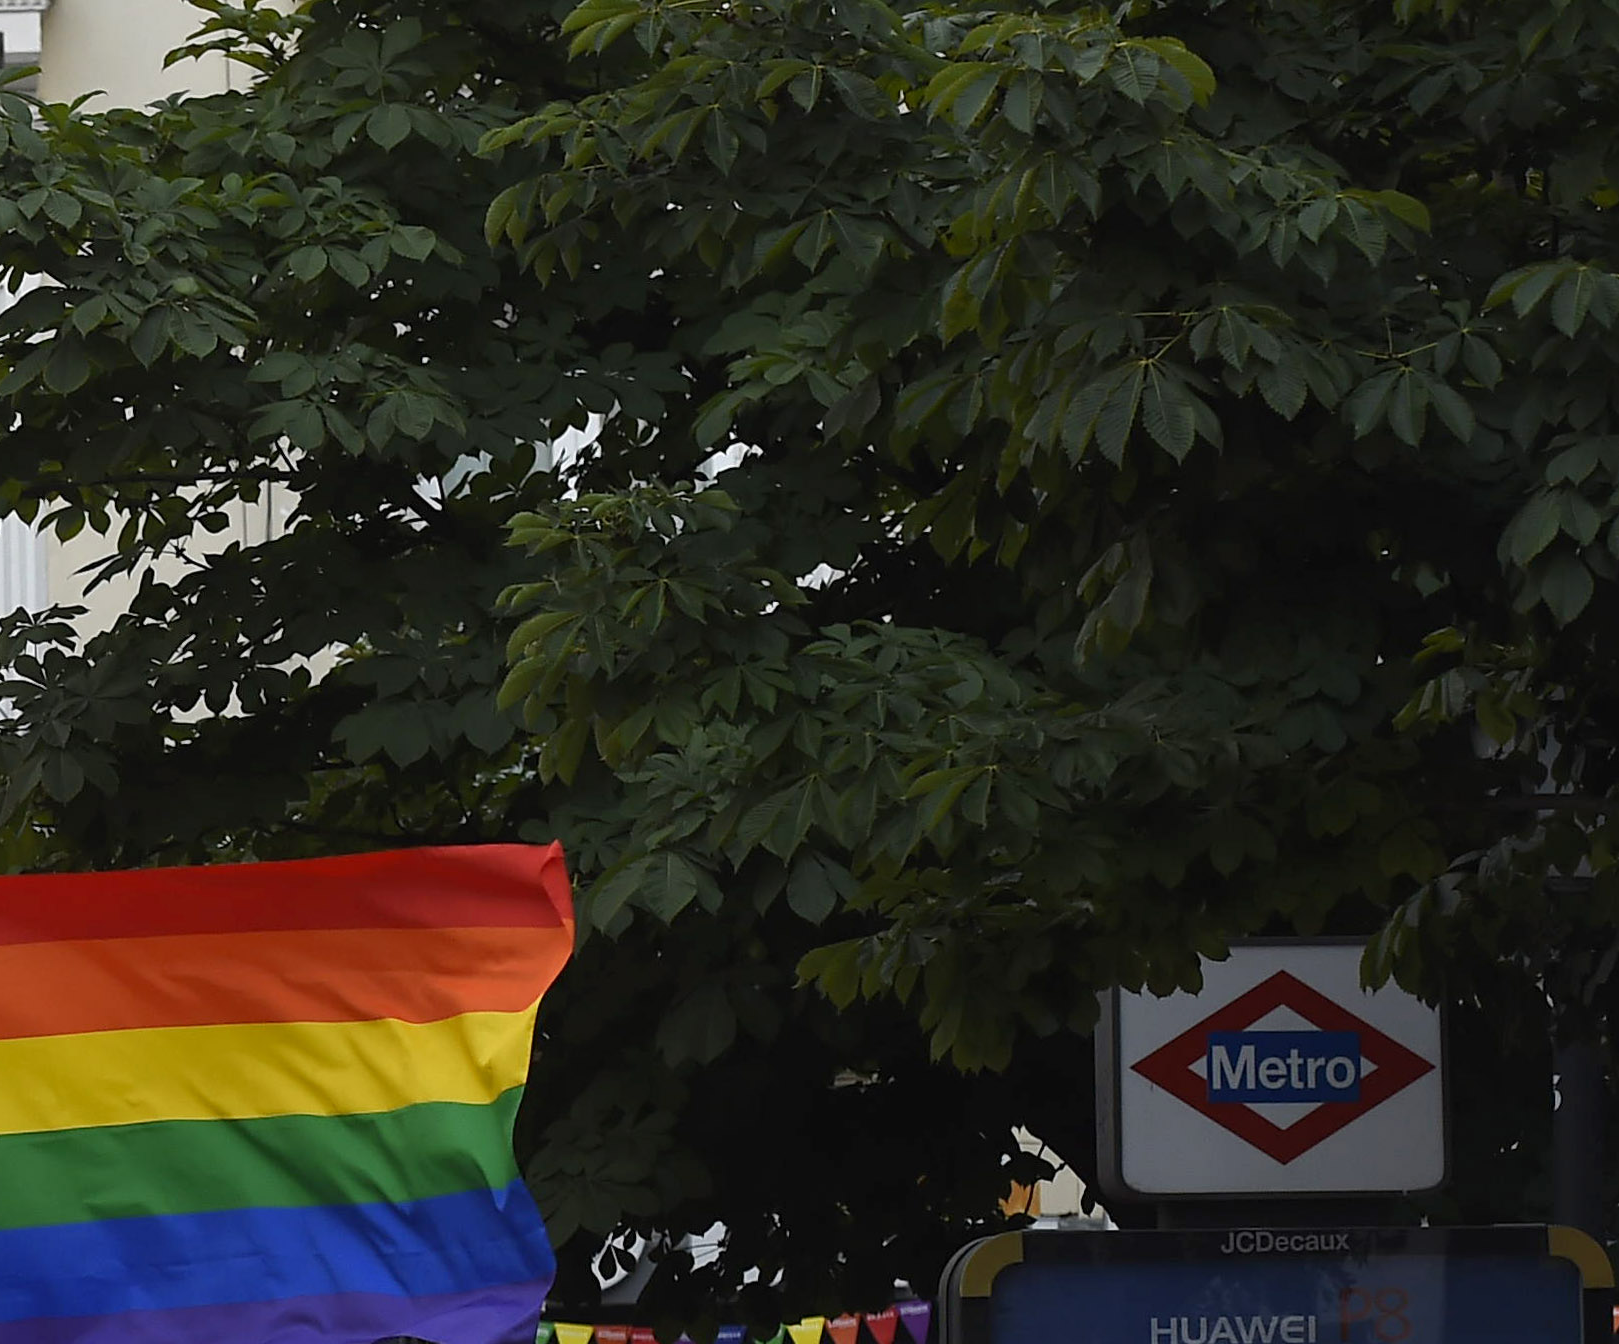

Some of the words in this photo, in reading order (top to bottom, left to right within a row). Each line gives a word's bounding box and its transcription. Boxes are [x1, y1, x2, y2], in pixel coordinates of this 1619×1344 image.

[1211, 1044, 1356, 1091] Metro
[1220, 1231, 1351, 1255] JCDecaux
[1340, 1287, 1411, 1343] P8
